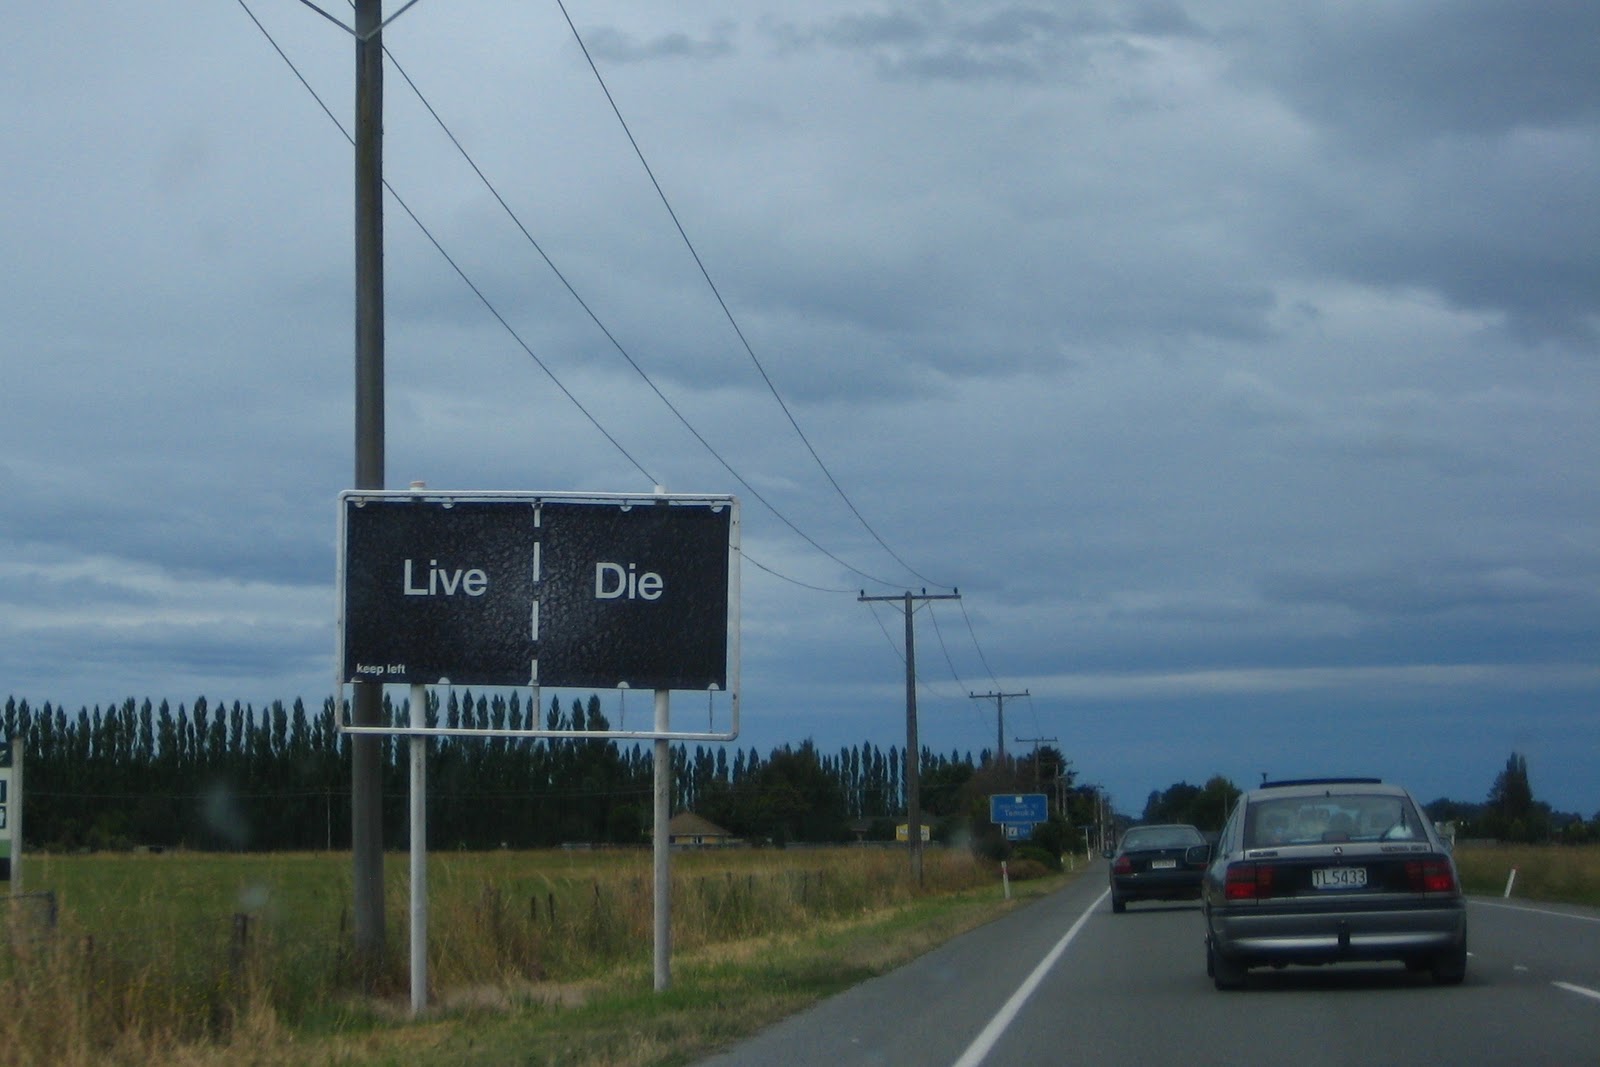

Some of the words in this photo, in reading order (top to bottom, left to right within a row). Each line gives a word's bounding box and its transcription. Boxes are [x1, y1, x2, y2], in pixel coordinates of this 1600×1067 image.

[404, 559, 488, 597] Live
[595, 562, 664, 601] Die
[356, 663, 384, 676] keep
[387, 663, 406, 674] left
[1313, 869, 1366, 885] TL5433
